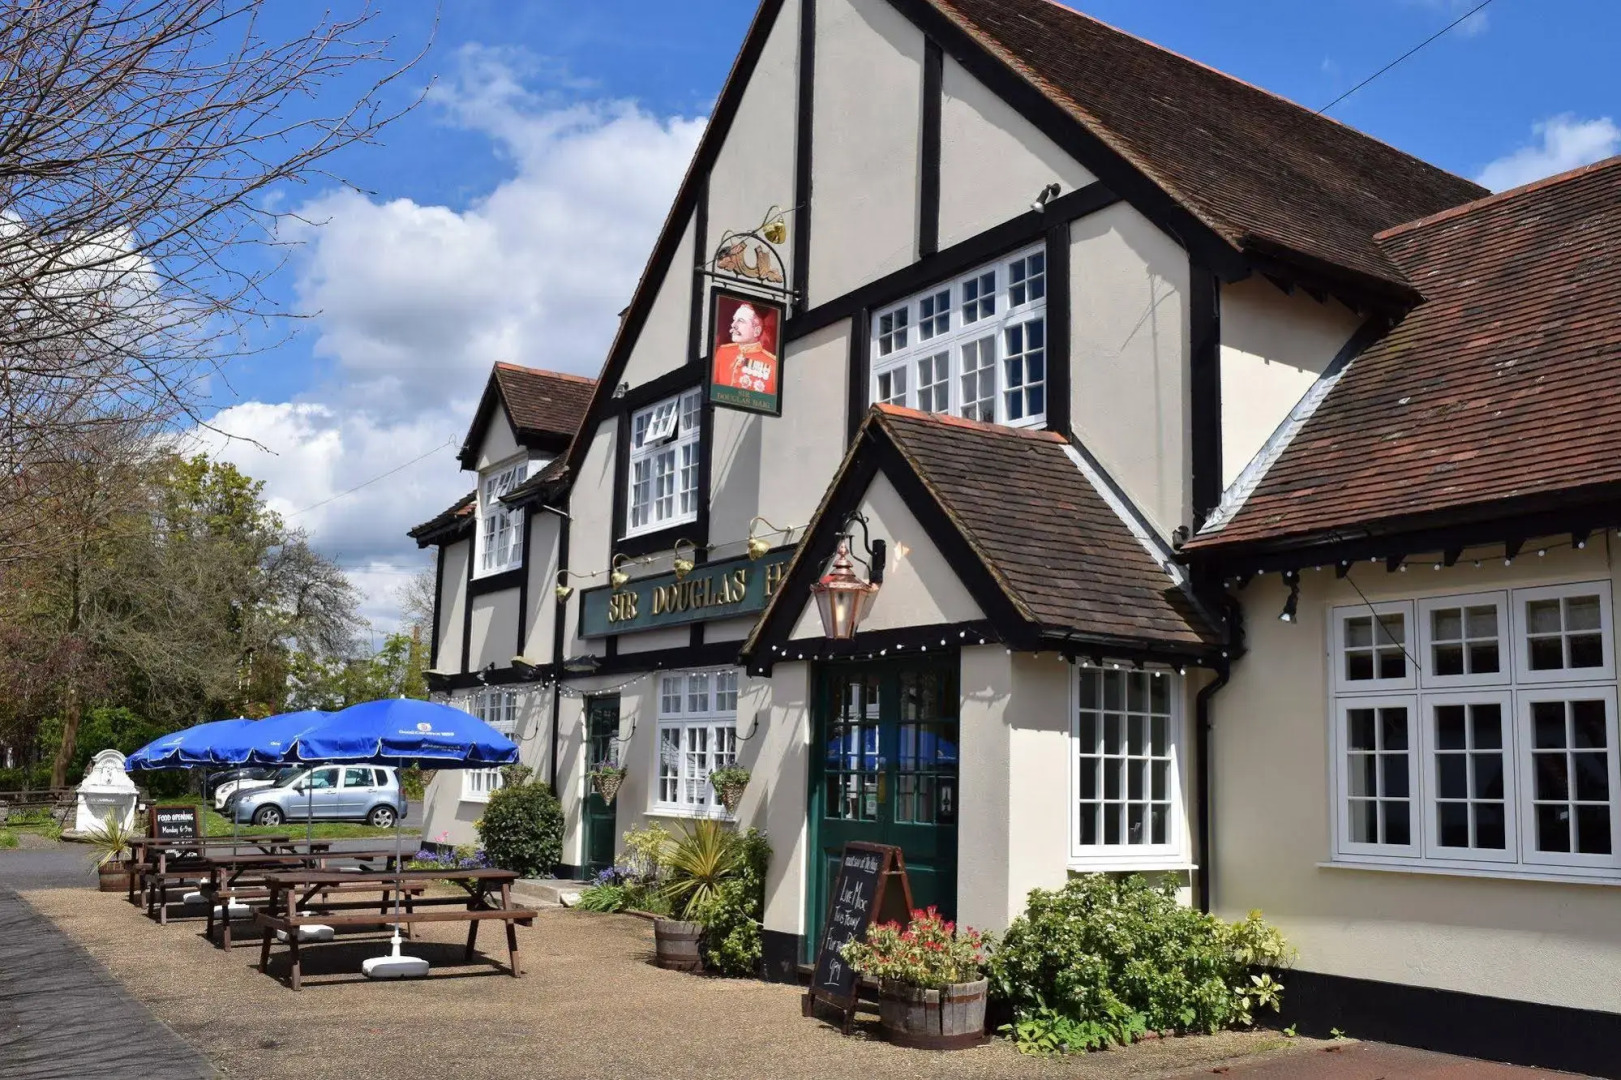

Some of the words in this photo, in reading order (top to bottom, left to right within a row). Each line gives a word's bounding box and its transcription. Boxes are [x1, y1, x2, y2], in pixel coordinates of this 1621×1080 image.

[608, 591, 638, 623] SIR
[652, 568, 747, 616] DOUGLAS
[764, 561, 786, 598] H
[157, 813, 171, 822] FOOD
[172, 812, 193, 821] OPENING
[162, 825, 179, 834] Monday
